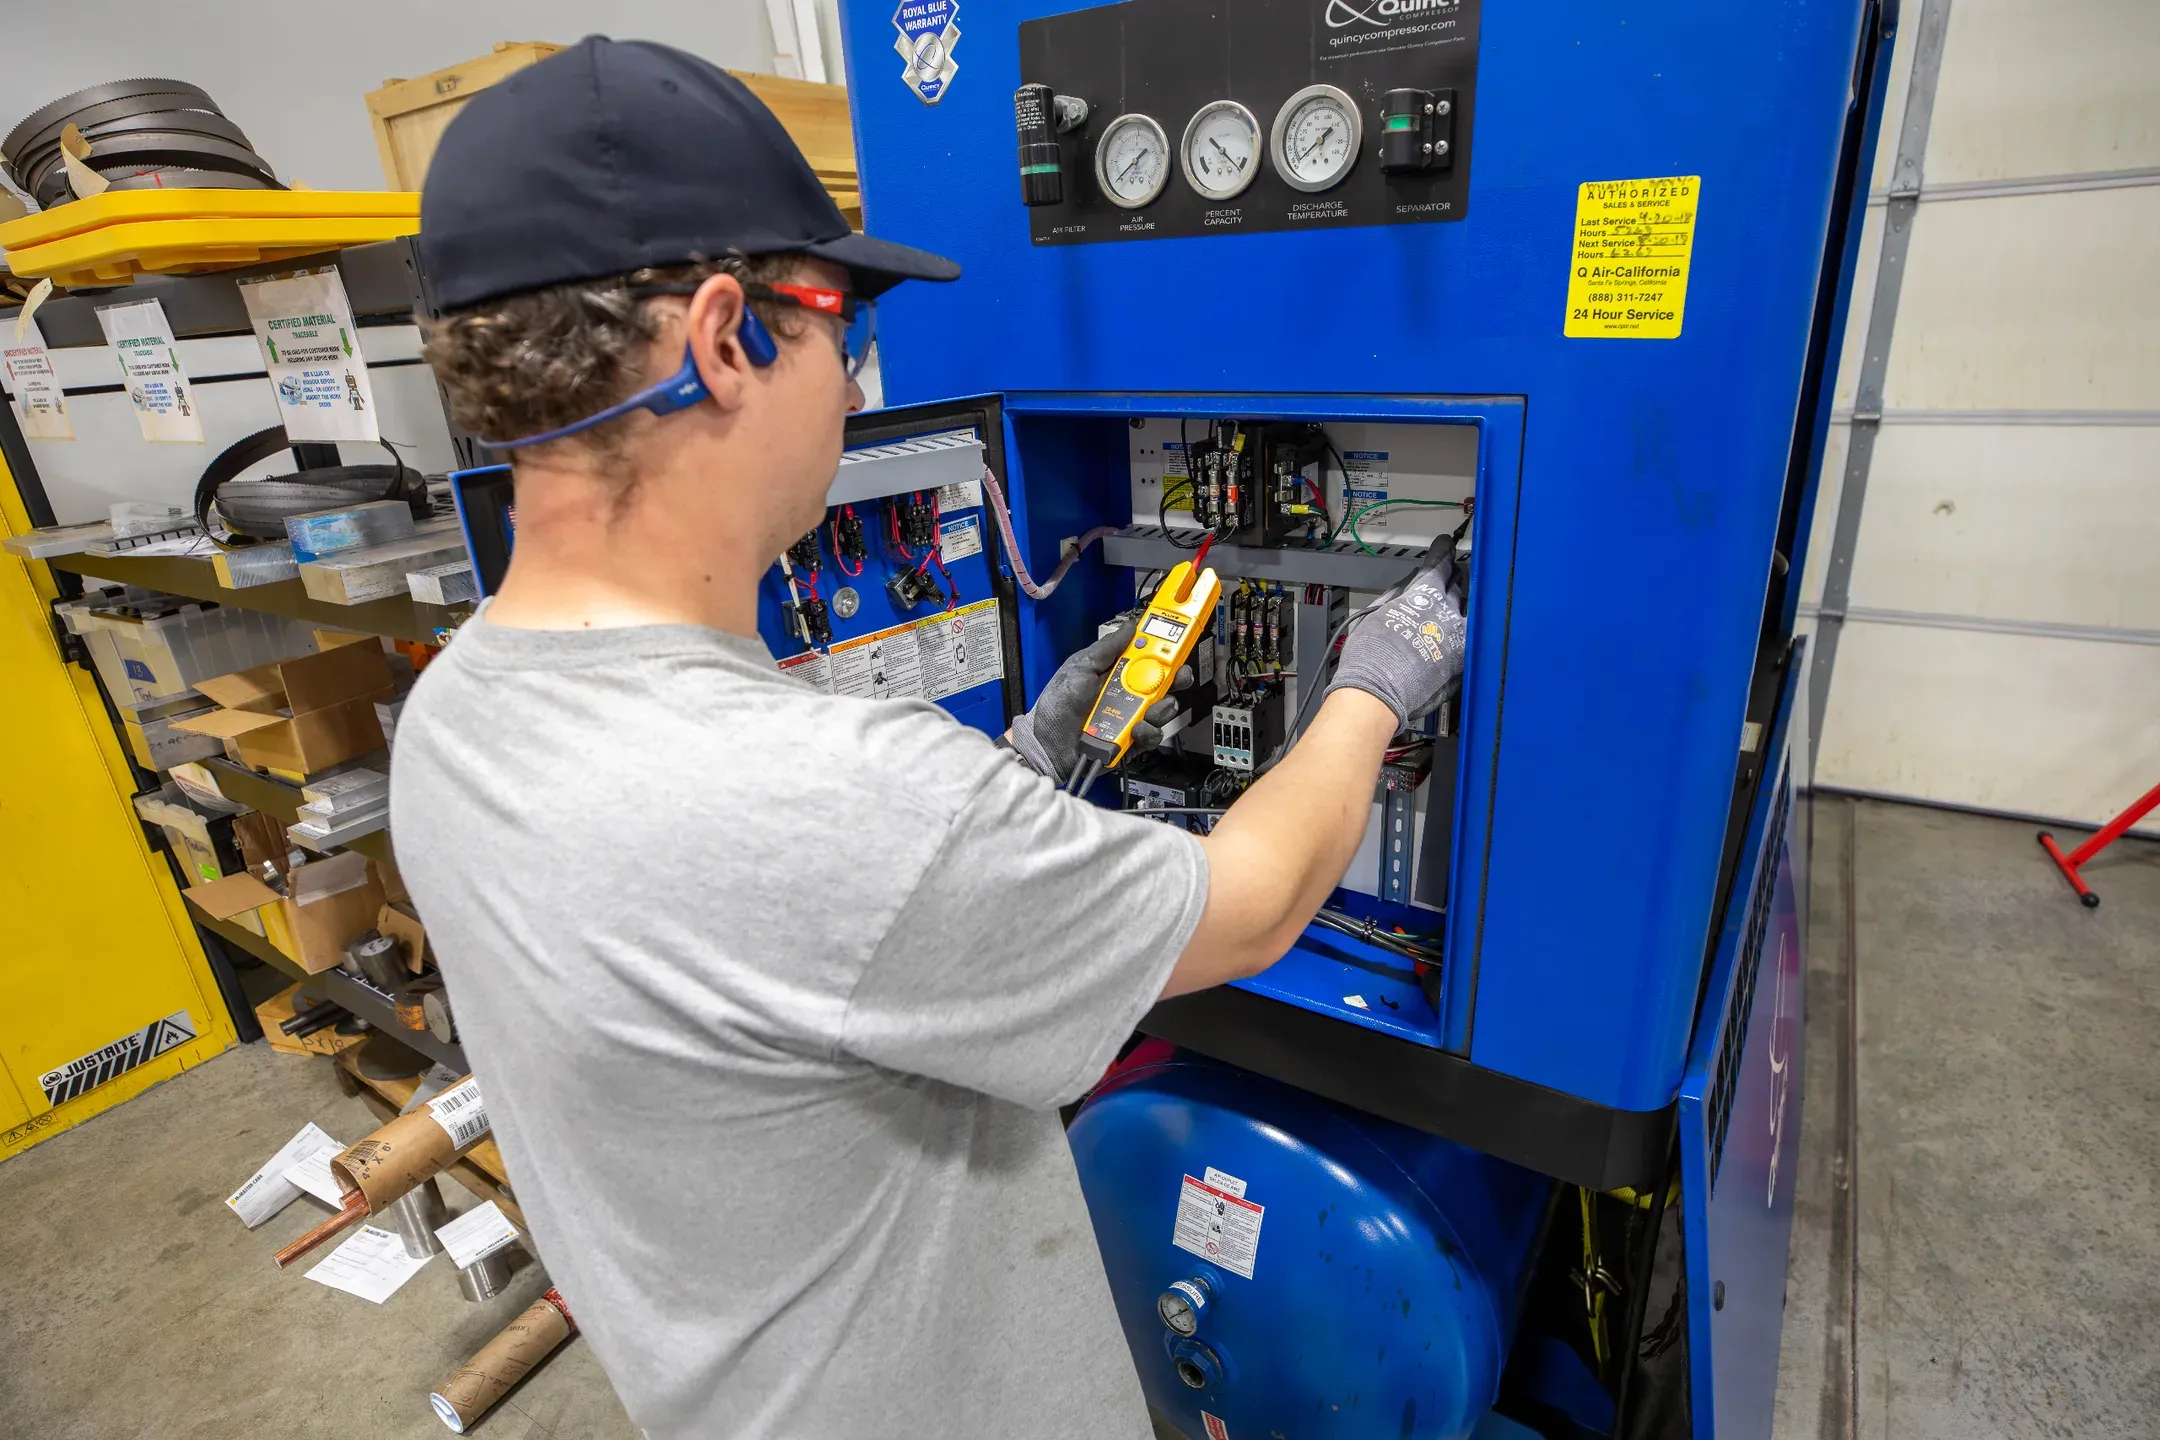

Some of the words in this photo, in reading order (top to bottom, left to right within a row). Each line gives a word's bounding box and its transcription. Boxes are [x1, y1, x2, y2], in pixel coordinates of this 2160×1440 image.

[902, 5, 927, 19] ROYAL
[927, 0, 947, 13] BLUE
[1399, 6, 1460, 21] COMPRESSOR
[904, 14, 947, 31] WARRANTY
[1329, 19, 1456, 47] quincycompressor.com
[1587, 187, 1690, 200] AUTHORIZED
[1292, 201, 1343, 212] DISCHARGE
[1396, 202, 1451, 213] SEPARATOR
[1637, 200, 1671, 208] SERVICE
[1205, 208, 1241, 218] PERCENT
[1287, 209, 1348, 220] TEMPERATURE
[1204, 216, 1243, 226] CAPACITY
[1581, 218, 1600, 226] Last
[1602, 217, 1636, 226] Service
[1052, 226, 1063, 234] AIR
[1064, 225, 1086, 233] FILTER
[1119, 223, 1155, 232] PRESSURE
[1579, 229, 1607, 237] Hours
[1578, 240, 1599, 248] Next
[1601, 239, 1635, 247] Service
[1577, 250, 1604, 258] Hours
[1577, 267, 1588, 278] Q
[1591, 265, 1681, 278] Air-California
[1588, 293, 1614, 303] (888)
[1616, 293, 1663, 302] 311-7247
[1573, 309, 1589, 320] 24
[1592, 309, 1624, 320] Hour
[1626, 309, 1675, 320] Service
[267, 317, 302, 331] CERTIFIED
[302, 313, 336, 327] MATERIAL
[292, 330, 319, 339] TRACEABLE
[116, 339, 141, 348] CERTIFIED
[140, 336, 165, 347] MATERIAL
[1353, 452, 1378, 460] NOTICE
[948, 520, 969, 532] NOTICE
[132, 664, 144, 678] 13
[65, 1034, 139, 1079] JUSTRITE
[372, 1155, 384, 1165] X
